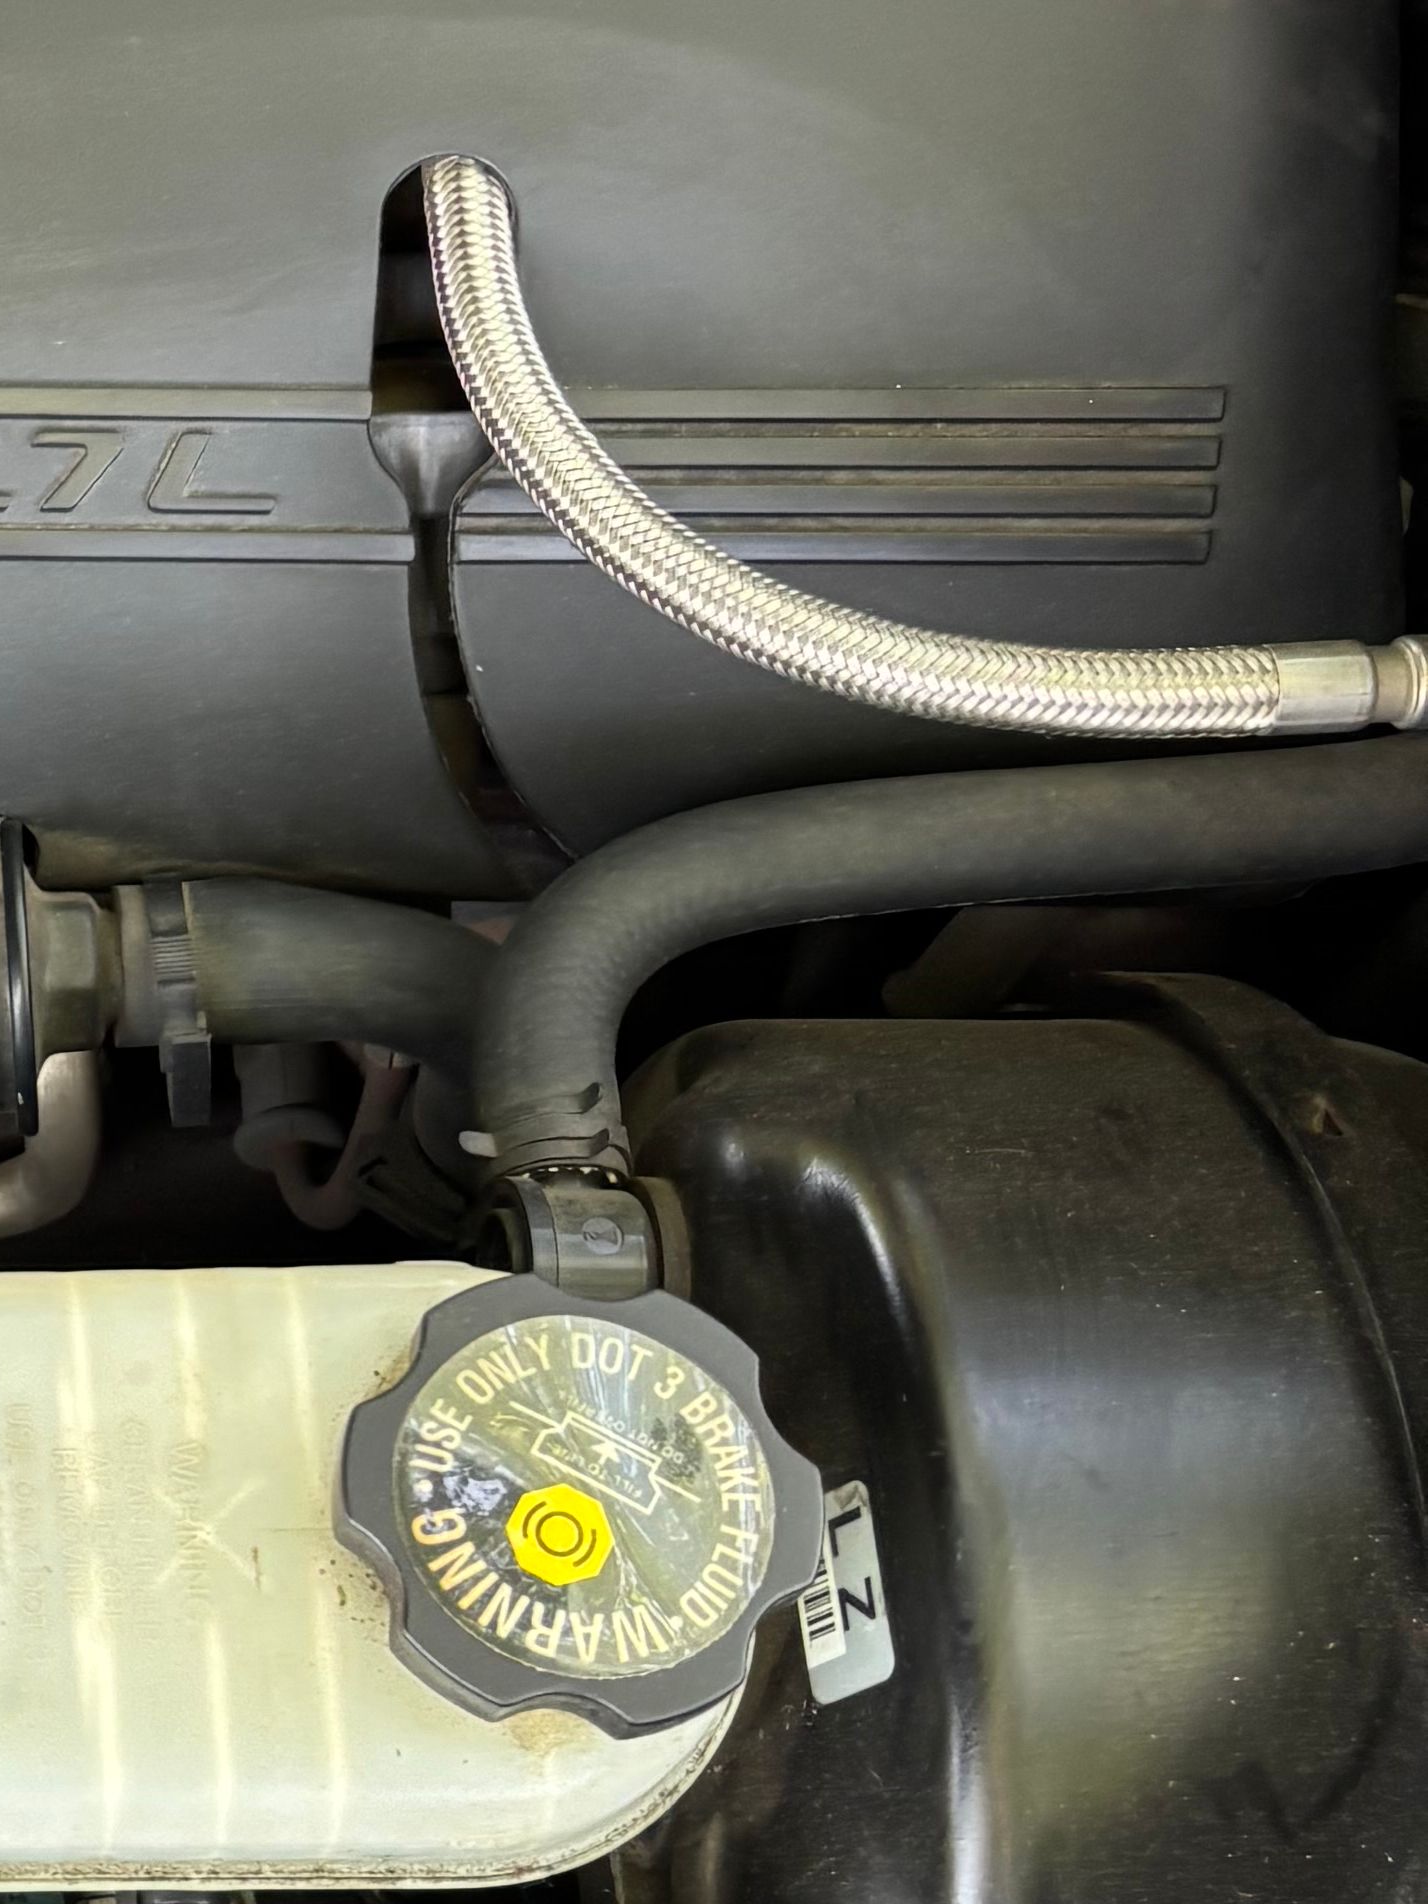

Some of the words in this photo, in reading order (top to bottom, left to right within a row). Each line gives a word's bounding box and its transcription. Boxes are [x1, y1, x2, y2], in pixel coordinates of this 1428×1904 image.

[456, 1333, 553, 1405] ONLY
[571, 1332, 653, 1382] DOT
[654, 1364, 686, 1401] 3
[424, 1398, 472, 1473] USE
[680, 1390, 761, 1523] BRAKE
[411, 1507, 669, 1664] WARNING
[680, 1525, 759, 1629] FLUID
